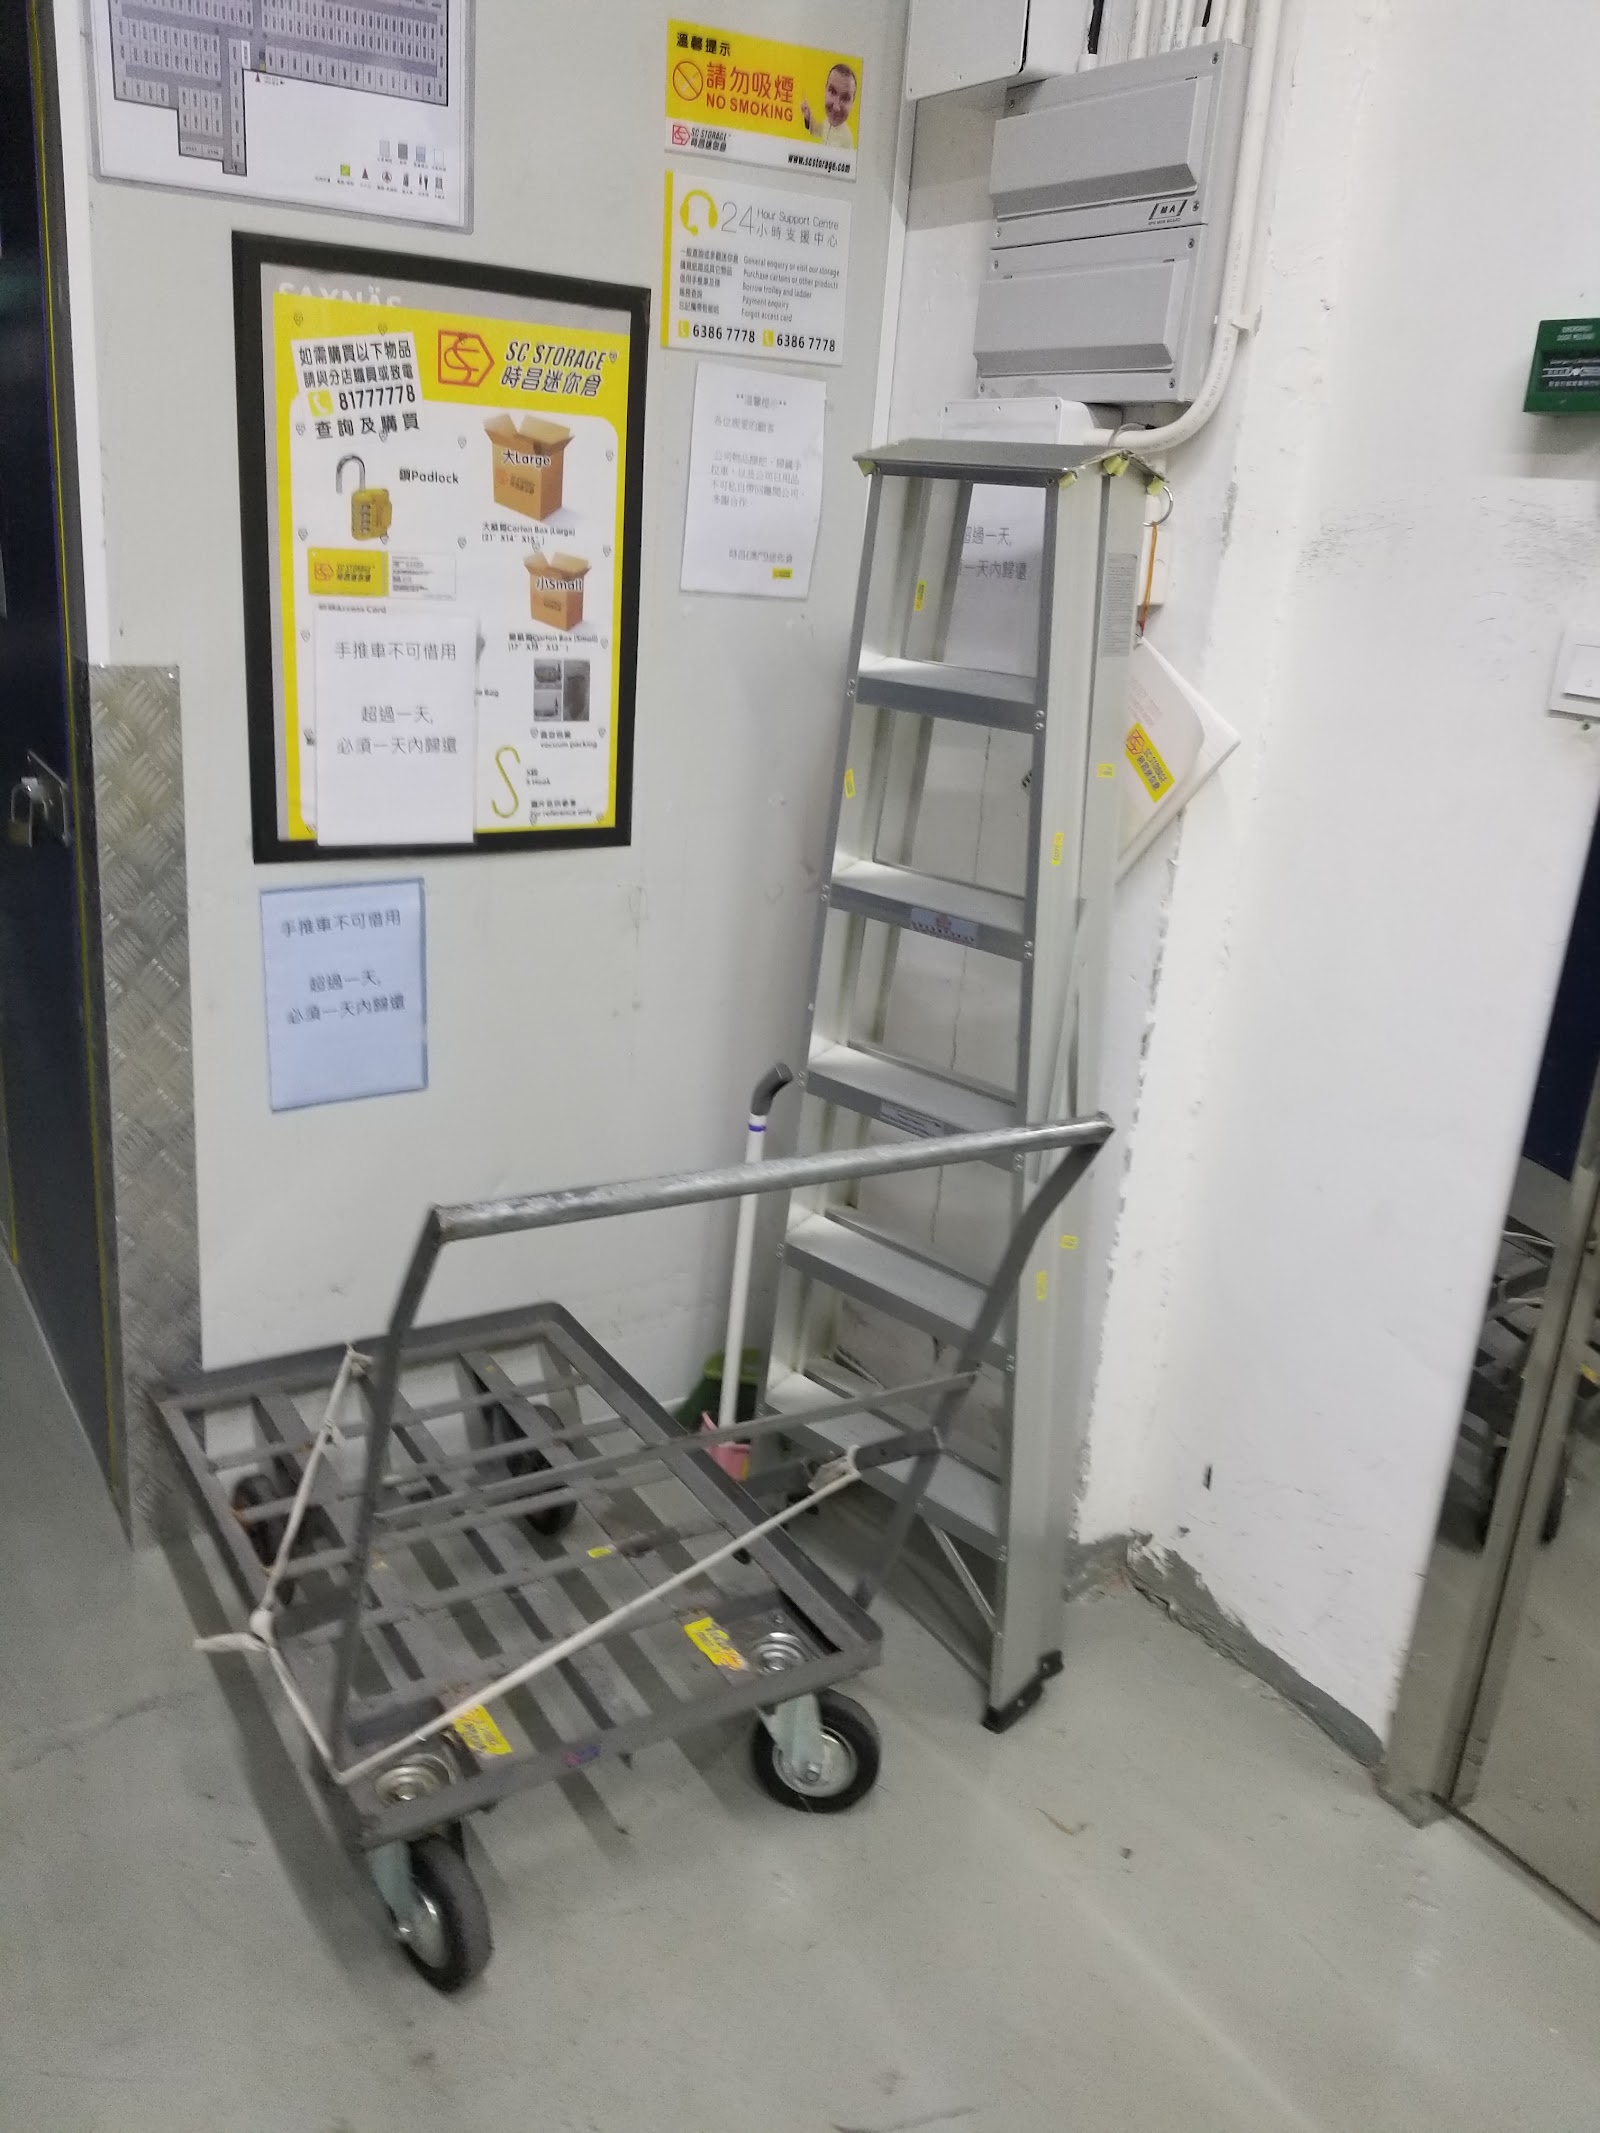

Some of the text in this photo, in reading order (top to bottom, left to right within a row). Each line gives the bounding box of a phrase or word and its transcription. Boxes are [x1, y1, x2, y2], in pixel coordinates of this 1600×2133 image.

[676, 31, 731, 57] 溫馨提示
[706, 61, 794, 103] 請勿吸煙
[706, 93, 794, 122] NO SMOKING
[691, 128, 728, 142] SC STORAGE
[787, 153, 851, 174] www.scstorage.com
[720, 201, 839, 235] 24 Hour Support Centre
[756, 223, 839, 248] 小時支援中心
[743, 256, 766, 267] General
[767, 260, 788, 271] enquiry
[820, 267, 840, 278] storage
[743, 268, 769, 280] Purchase
[769, 273, 791, 283] cartons
[798, 277, 814, 286] other
[814, 280, 839, 289] products
[742, 281, 812, 298] Borrow trolley and ladder
[742, 295, 789, 310] Payment enquiry
[741, 308, 793, 322] Forgot access card
[692, 324, 836, 353] 6386 7778 6386 7778
[299, 339, 412, 367] 如需購買以下物品
[505, 340, 607, 371] SC STORAGE
[302, 362, 414, 389] 請與分店職員或致電
[500, 365, 603, 397] 時昌迷你倉
[338, 384, 416, 411] 81777778
[314, 412, 420, 440] 查詢及購買
[334, 640, 457, 662] 手推車不可借用
[281, 908, 402, 938] 手推車不可借用
[286, 992, 406, 1025] 必須一天內歸還
